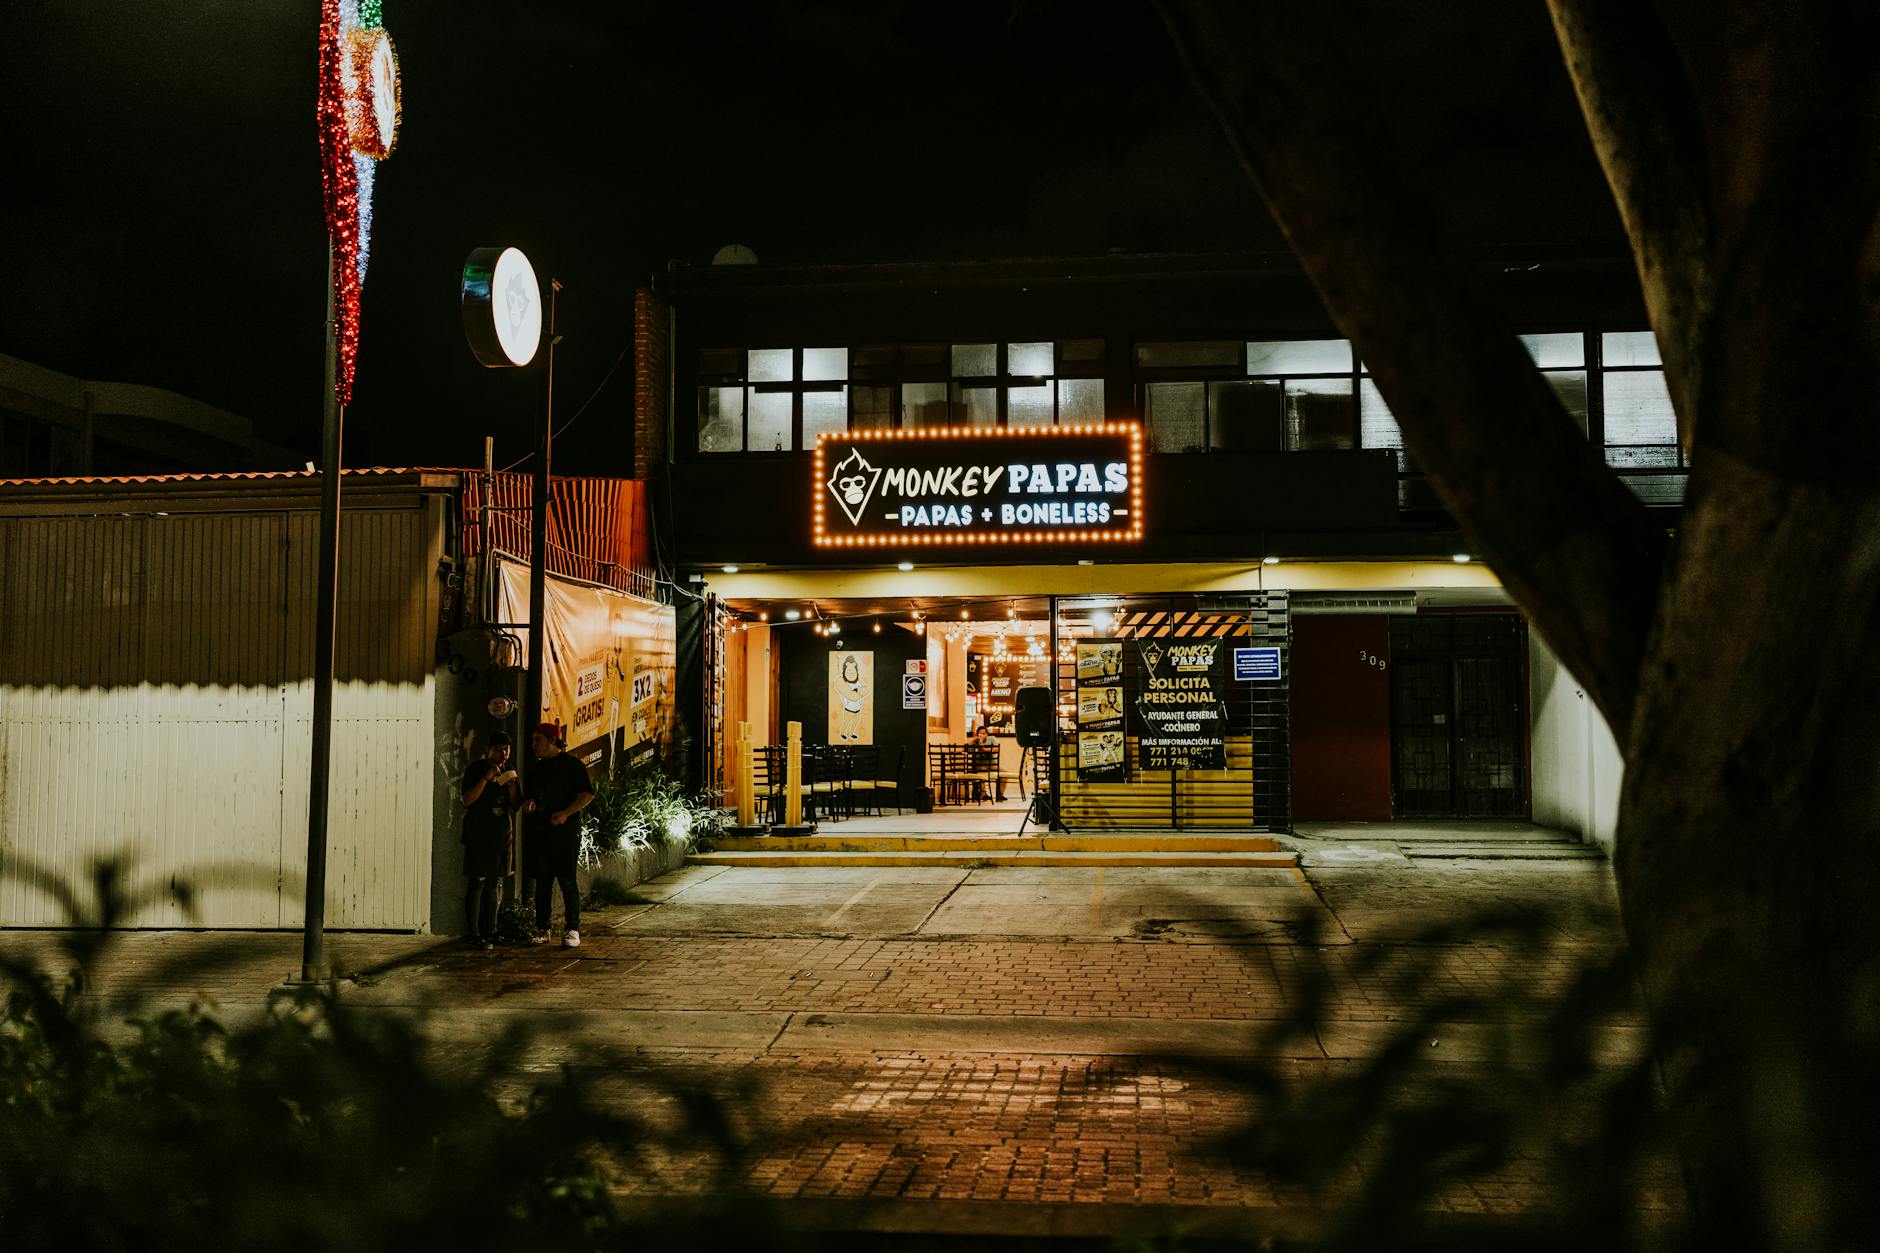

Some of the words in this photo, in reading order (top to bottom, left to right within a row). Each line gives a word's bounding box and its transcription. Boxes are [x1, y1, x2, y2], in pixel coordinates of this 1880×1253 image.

[881, 465, 1004, 497] MONKEY
[1008, 462, 1129, 494] PAPAS
[901, 504, 973, 526] PAPAS
[1001, 503, 1110, 525] BONELESS
[1167, 644, 1217, 657] MONKEY
[1171, 655, 1214, 667] PAPAS
[1360, 650, 1386, 670] 309
[577, 676, 584, 697] 2
[634, 674, 652, 703] 3X2
[1148, 677, 1211, 690] SOLICITA
[1143, 692, 1217, 704] PERSONAL
[572, 698, 605, 733] ¡GRATIS!
[1185, 711, 1219, 720] GENERAL
[1141, 737, 1158, 746] MÁS
[1150, 746, 1167, 755] 771
[1171, 746, 1189, 755] 214
[1150, 757, 1167, 766] 771
[1171, 757, 1189, 766] 748
